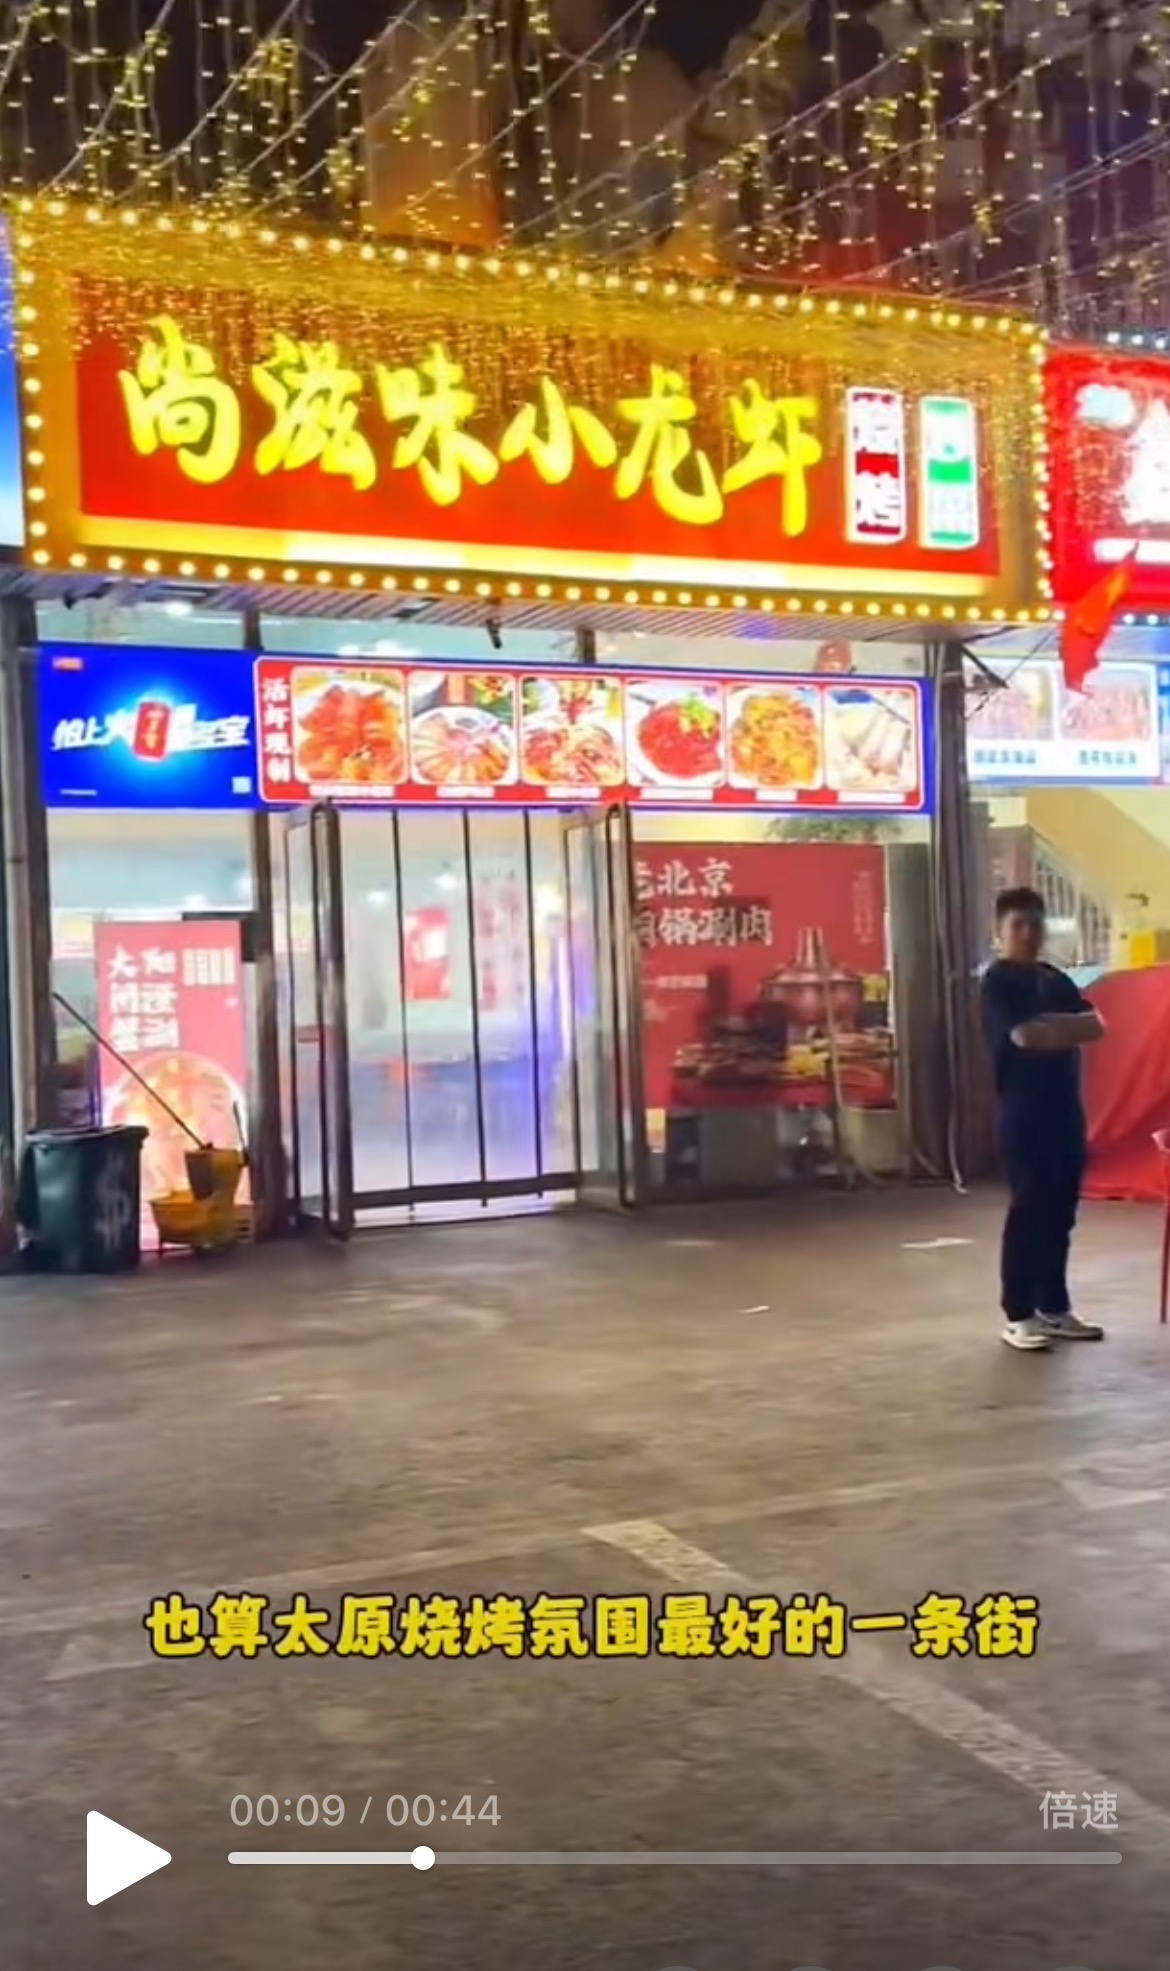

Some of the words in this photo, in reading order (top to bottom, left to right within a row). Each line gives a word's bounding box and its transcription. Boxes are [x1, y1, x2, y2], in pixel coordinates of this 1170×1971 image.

[117, 315, 822, 537] 尚滋味小龙虾
